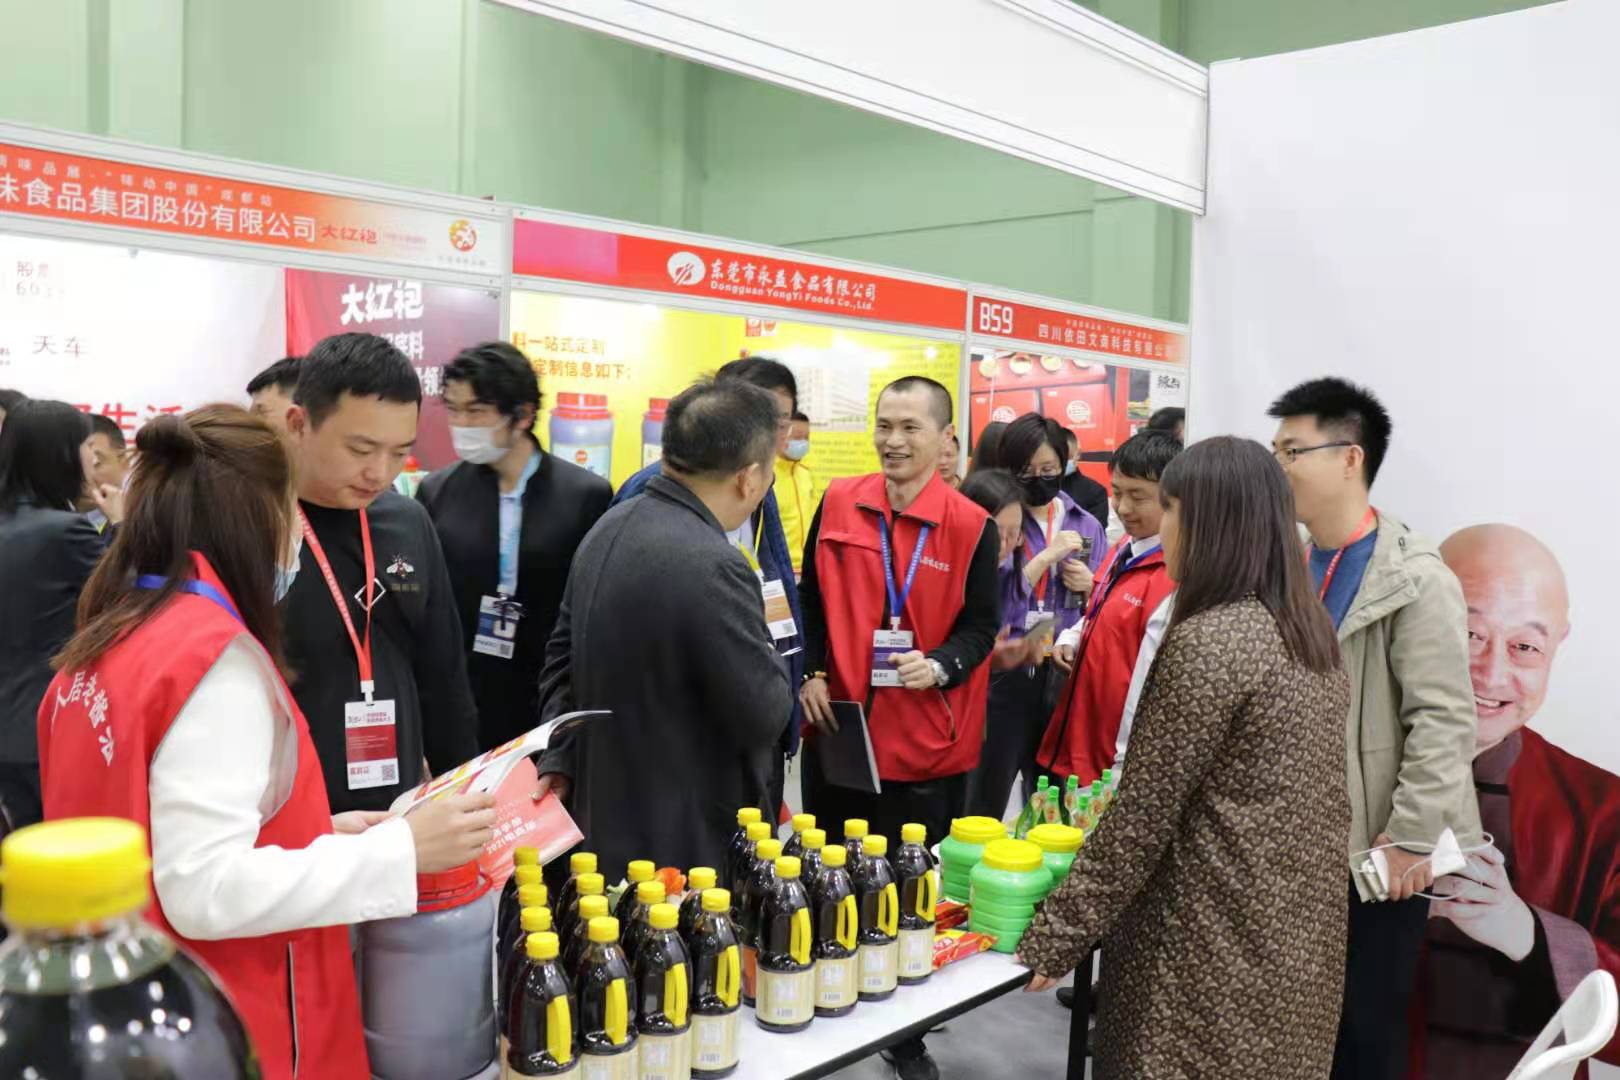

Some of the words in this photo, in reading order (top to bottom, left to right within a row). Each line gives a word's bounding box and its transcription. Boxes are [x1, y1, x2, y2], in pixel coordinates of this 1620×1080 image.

[321, 224, 378, 245] 大红袍
[710, 258, 876, 302] 东莞市永益食品有限公司
[710, 280, 764, 297] Dongguan
[766, 287, 802, 302] YongYi
[805, 292, 836, 306] Foods
[340, 279, 424, 326] 大红袍
[979, 301, 1014, 335] B59
